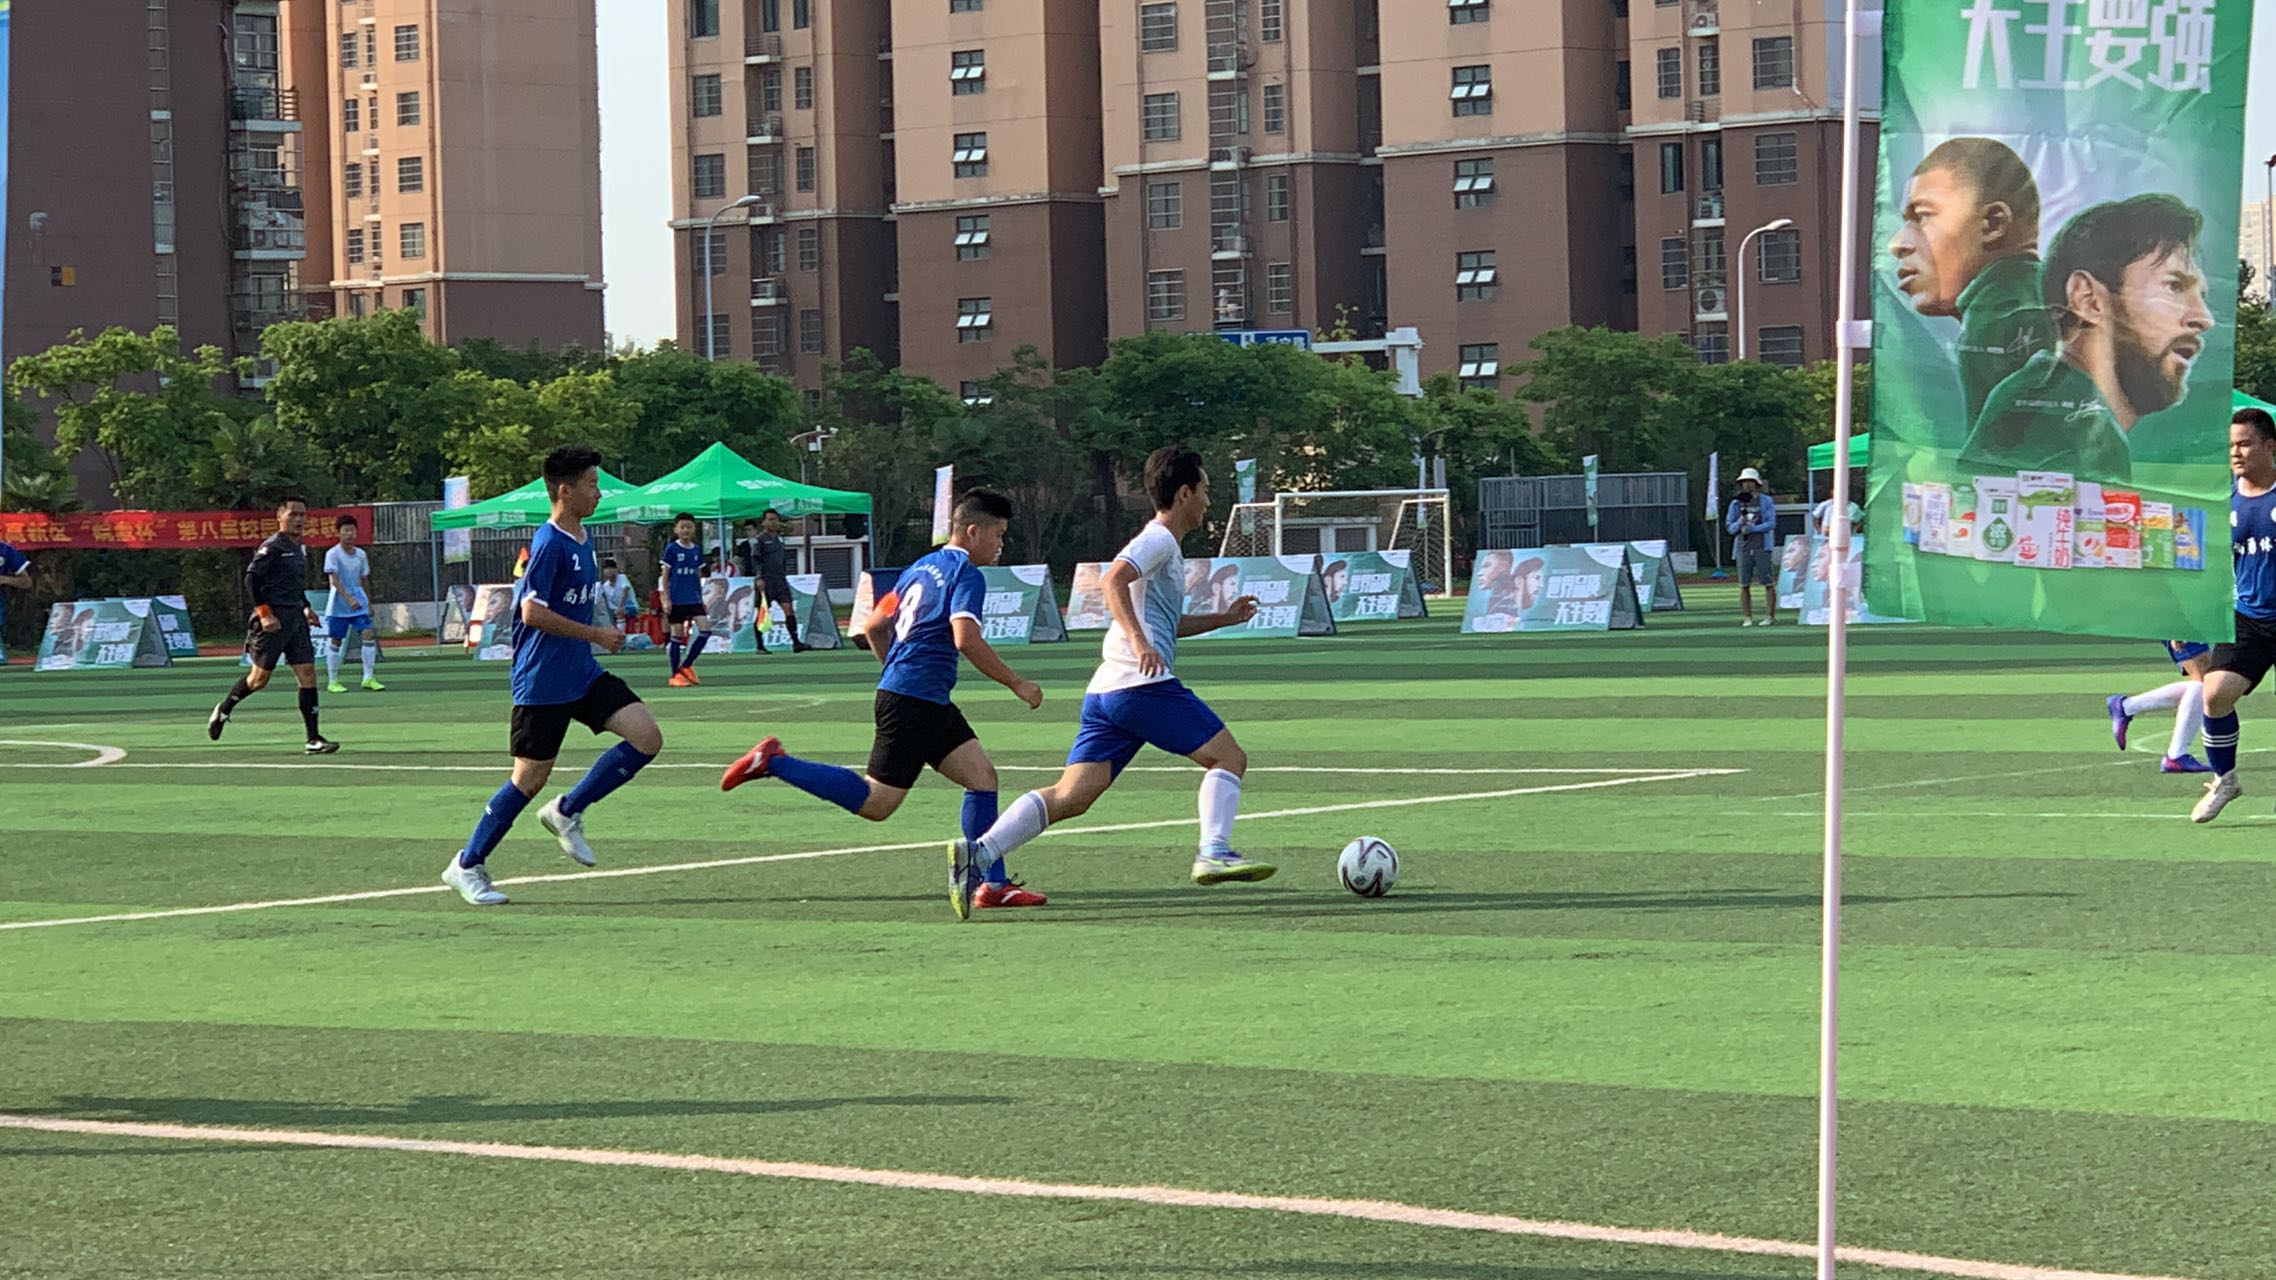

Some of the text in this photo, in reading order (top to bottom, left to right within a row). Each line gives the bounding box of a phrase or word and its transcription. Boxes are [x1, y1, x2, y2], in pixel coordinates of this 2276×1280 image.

[0, 522, 72, 543] 高新区
[177, 514, 340, 541] 第八届校园球联
[571, 553, 582, 571] 2
[895, 582, 924, 643] 8
